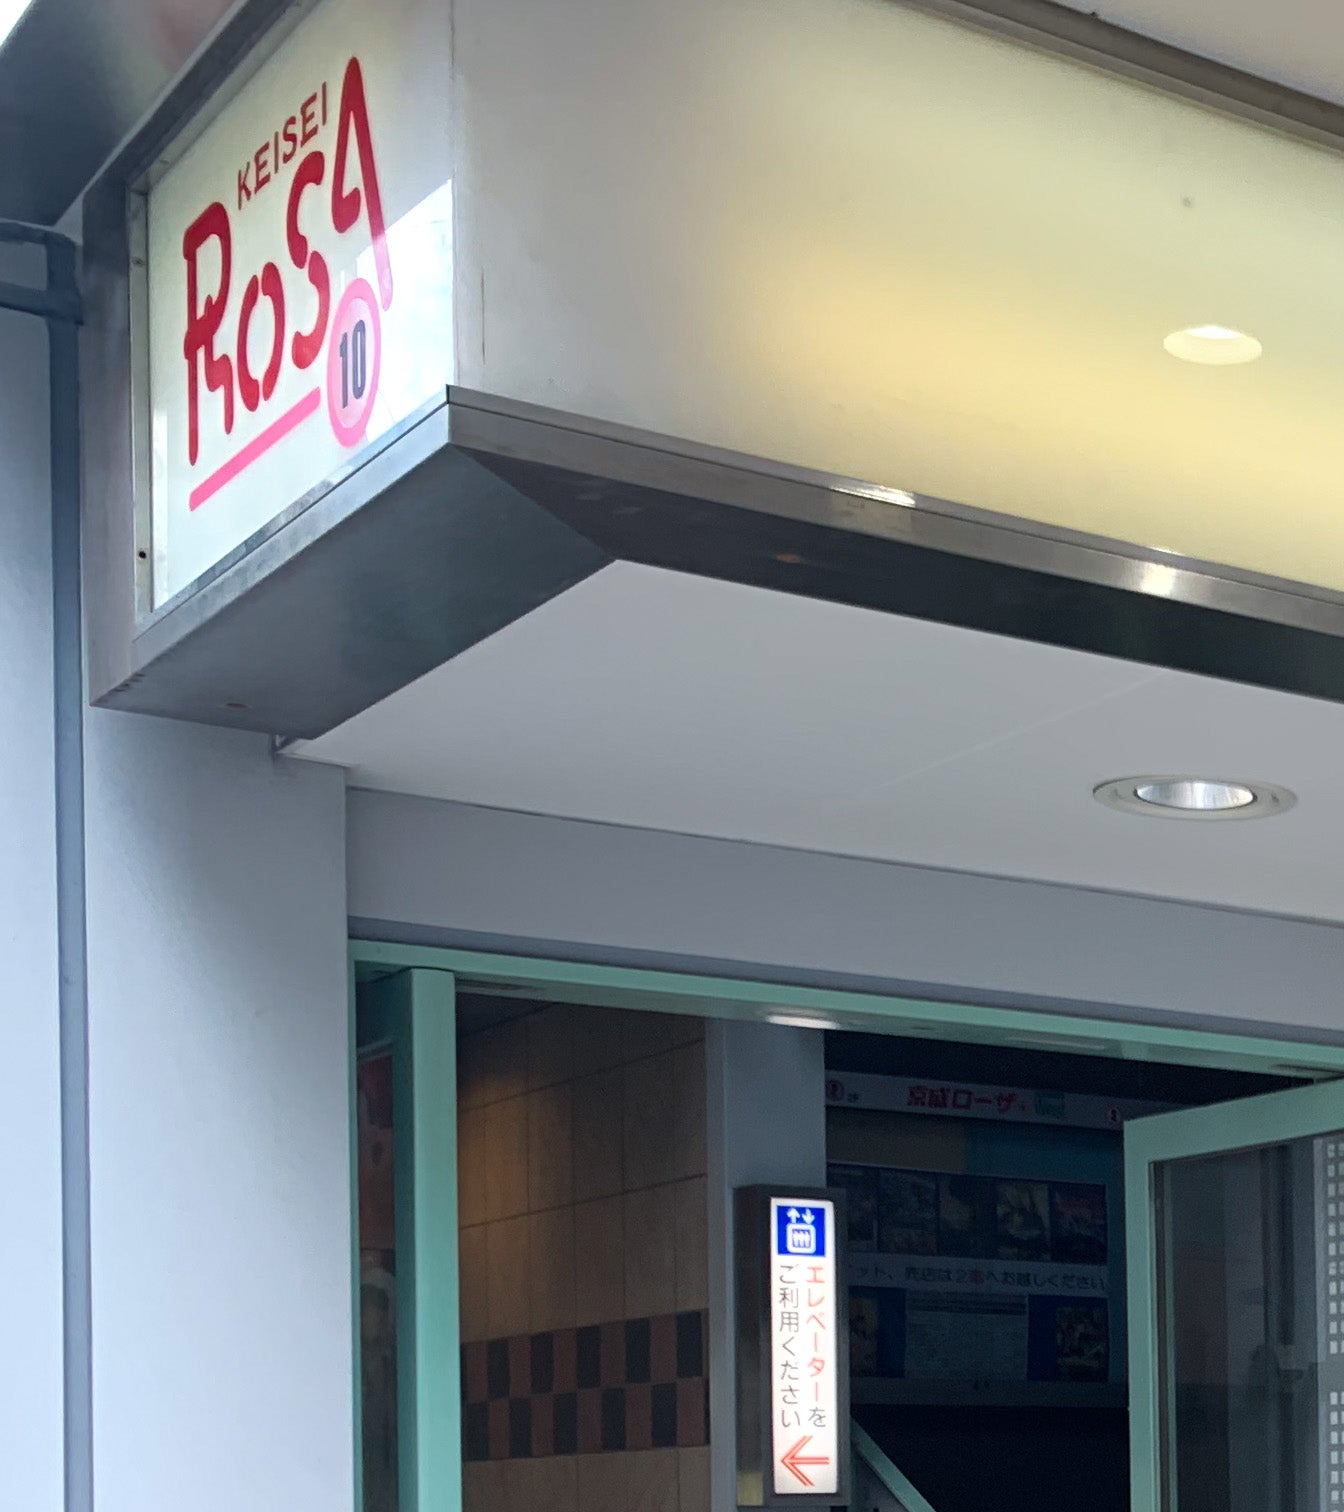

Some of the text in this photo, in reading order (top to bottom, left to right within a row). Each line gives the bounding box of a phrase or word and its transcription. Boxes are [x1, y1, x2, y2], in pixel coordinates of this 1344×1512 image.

[237, 82, 329, 210] KEISEI
[183, 56, 393, 465] ROSA
[340, 320, 366, 409] 10
[779, 1263, 801, 1428] ご利用ください
[806, 1265, 827, 1428] エレベーターを
